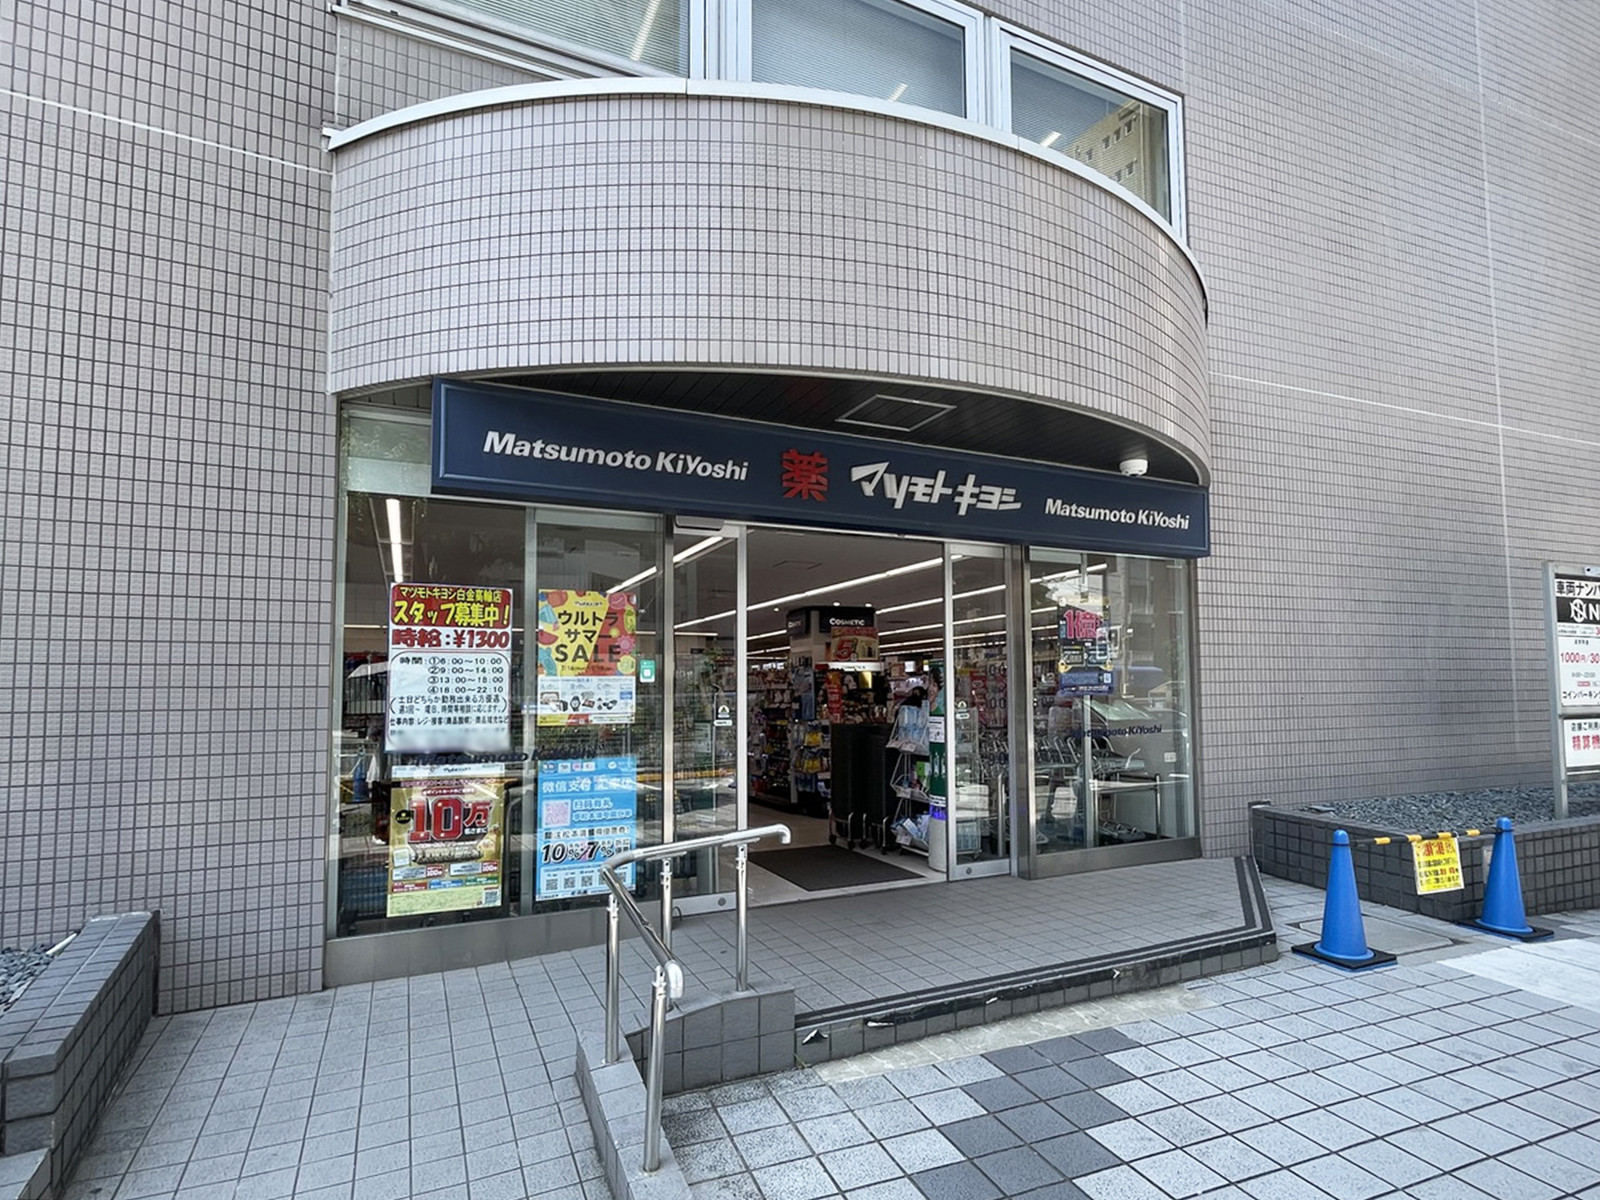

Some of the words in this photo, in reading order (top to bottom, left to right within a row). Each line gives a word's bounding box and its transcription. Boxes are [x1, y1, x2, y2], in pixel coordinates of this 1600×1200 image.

[483, 430, 652, 471] Matsumoto
[655, 451, 749, 481] KiYoshi
[781, 448, 829, 501] 薬
[850, 461, 1021, 516] マツモトキヨシ
[1045, 498, 1136, 524] Matsumoto
[1137, 511, 1190, 531] KiYoshi
[557, 610, 619, 626] ウルトラ
[554, 644, 622, 663] SALE
